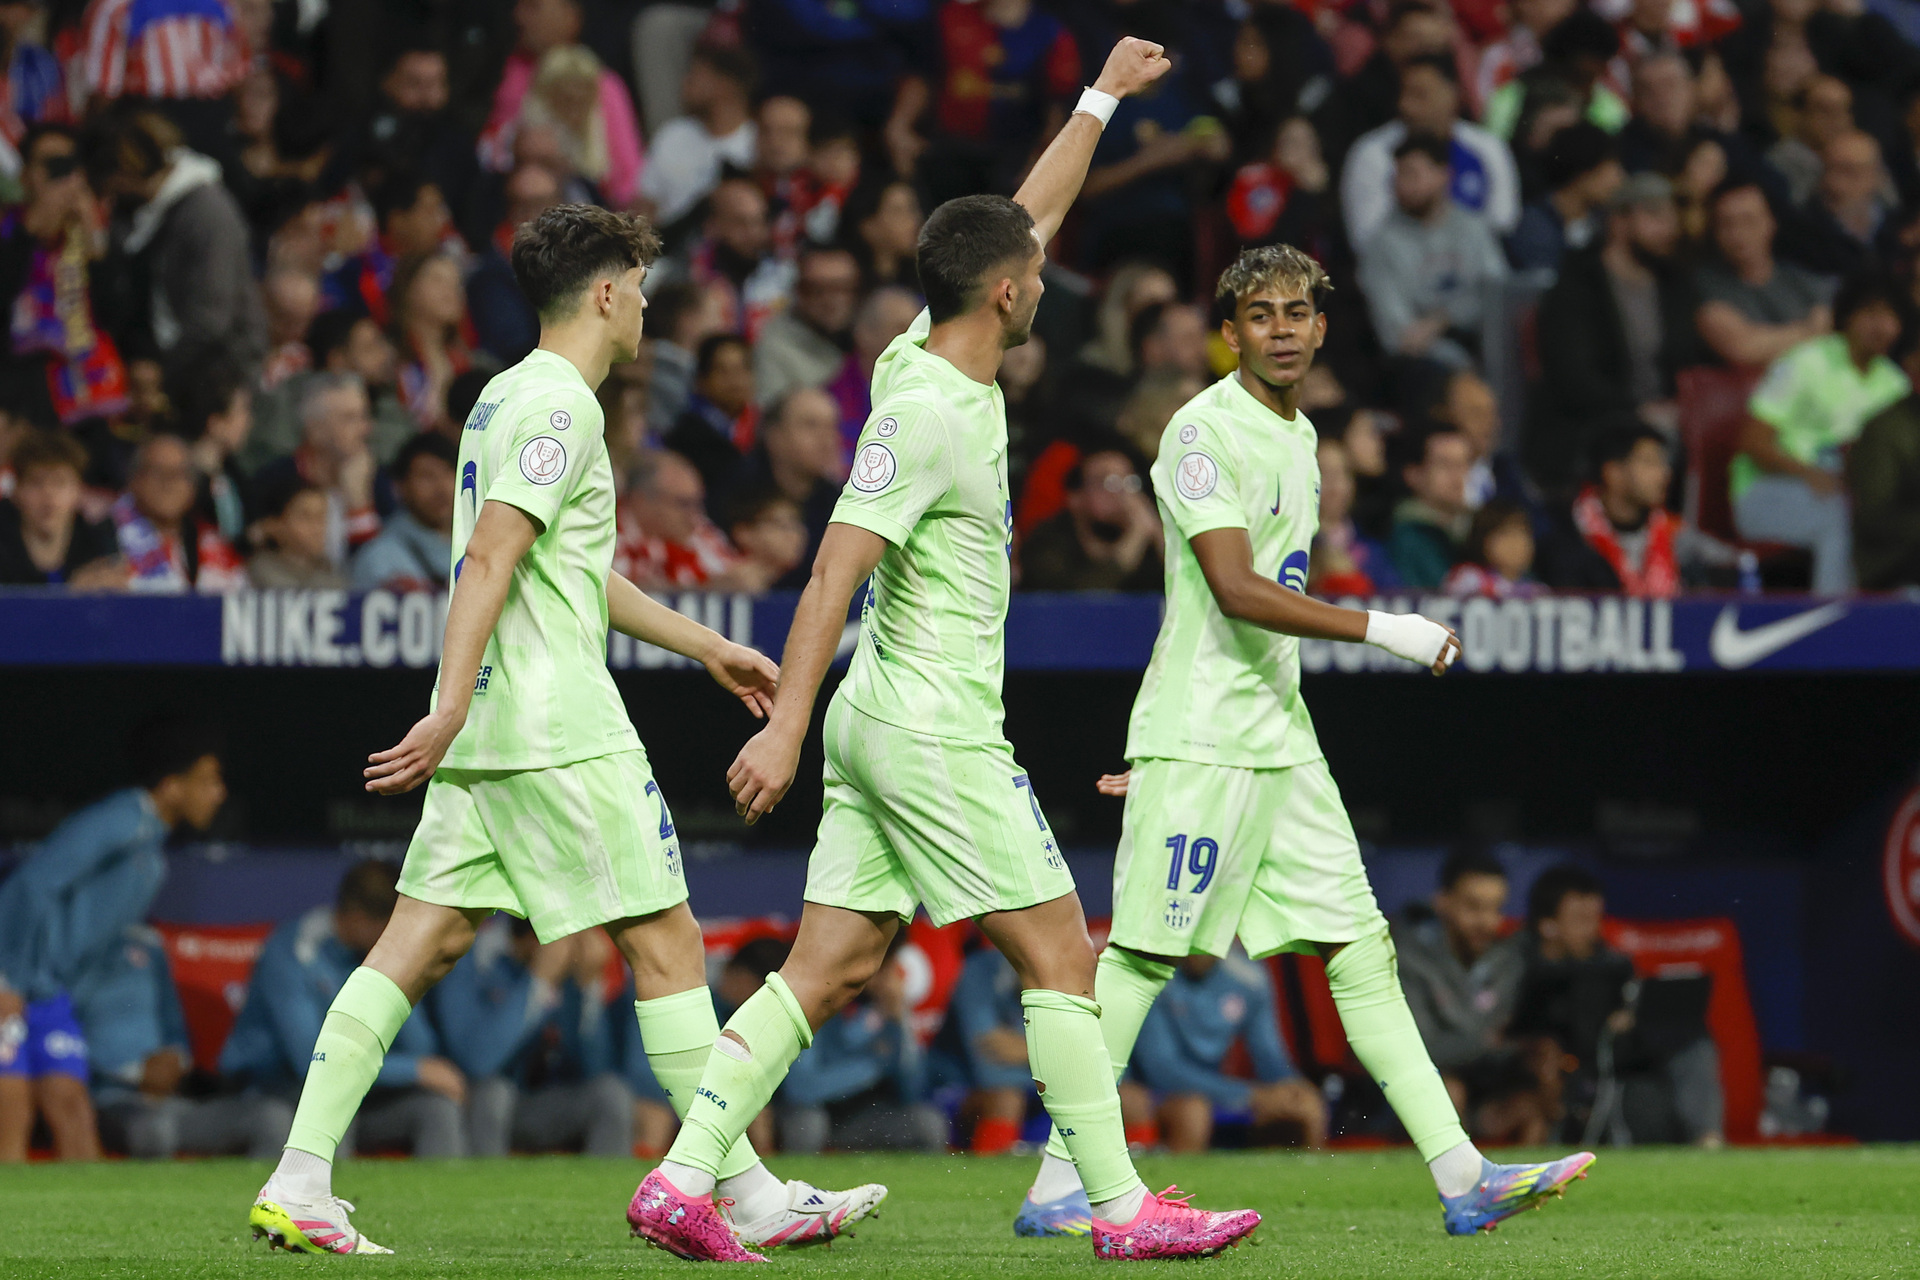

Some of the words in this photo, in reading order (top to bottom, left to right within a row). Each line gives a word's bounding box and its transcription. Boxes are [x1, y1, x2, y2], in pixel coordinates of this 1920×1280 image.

[554, 415, 567, 425] 31
[881, 423, 893, 432] 31
[1183, 430, 1194, 439] 31
[644, 779, 675, 841] 2
[1011, 773, 1047, 832] 7
[1165, 833, 1219, 894] 19
